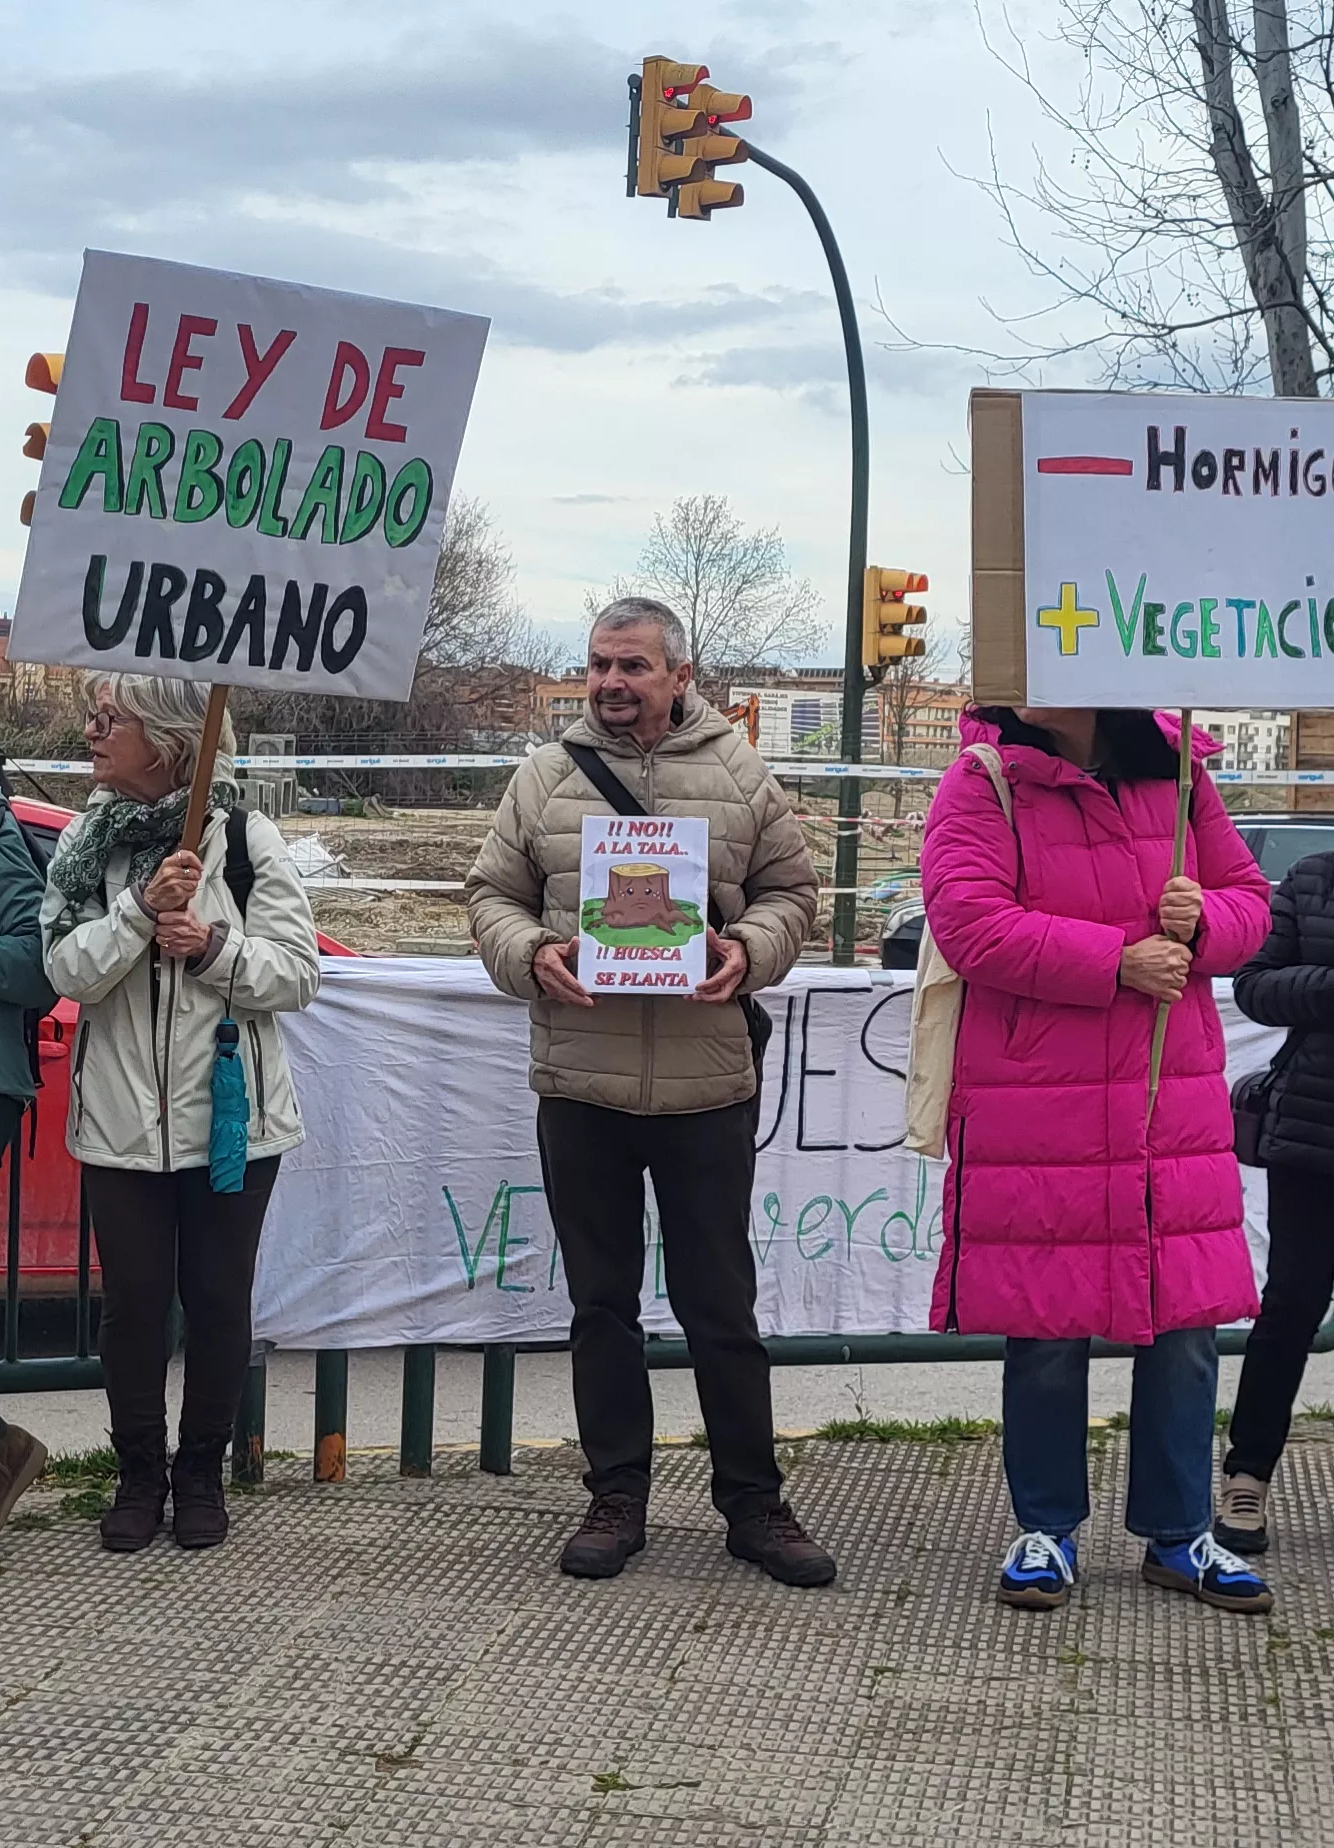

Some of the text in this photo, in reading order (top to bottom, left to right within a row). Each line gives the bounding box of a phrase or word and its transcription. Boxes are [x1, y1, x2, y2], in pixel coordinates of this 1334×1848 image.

[120, 302, 426, 444] LEY DE
[58, 416, 435, 548] ARBOLADO
[82, 554, 367, 675] URBANO
[594, 842, 607, 854] A
[610, 842, 633, 854] LA
[594, 972, 689, 986] SE PLANTA
[613, 947, 682, 961] HUESCA
